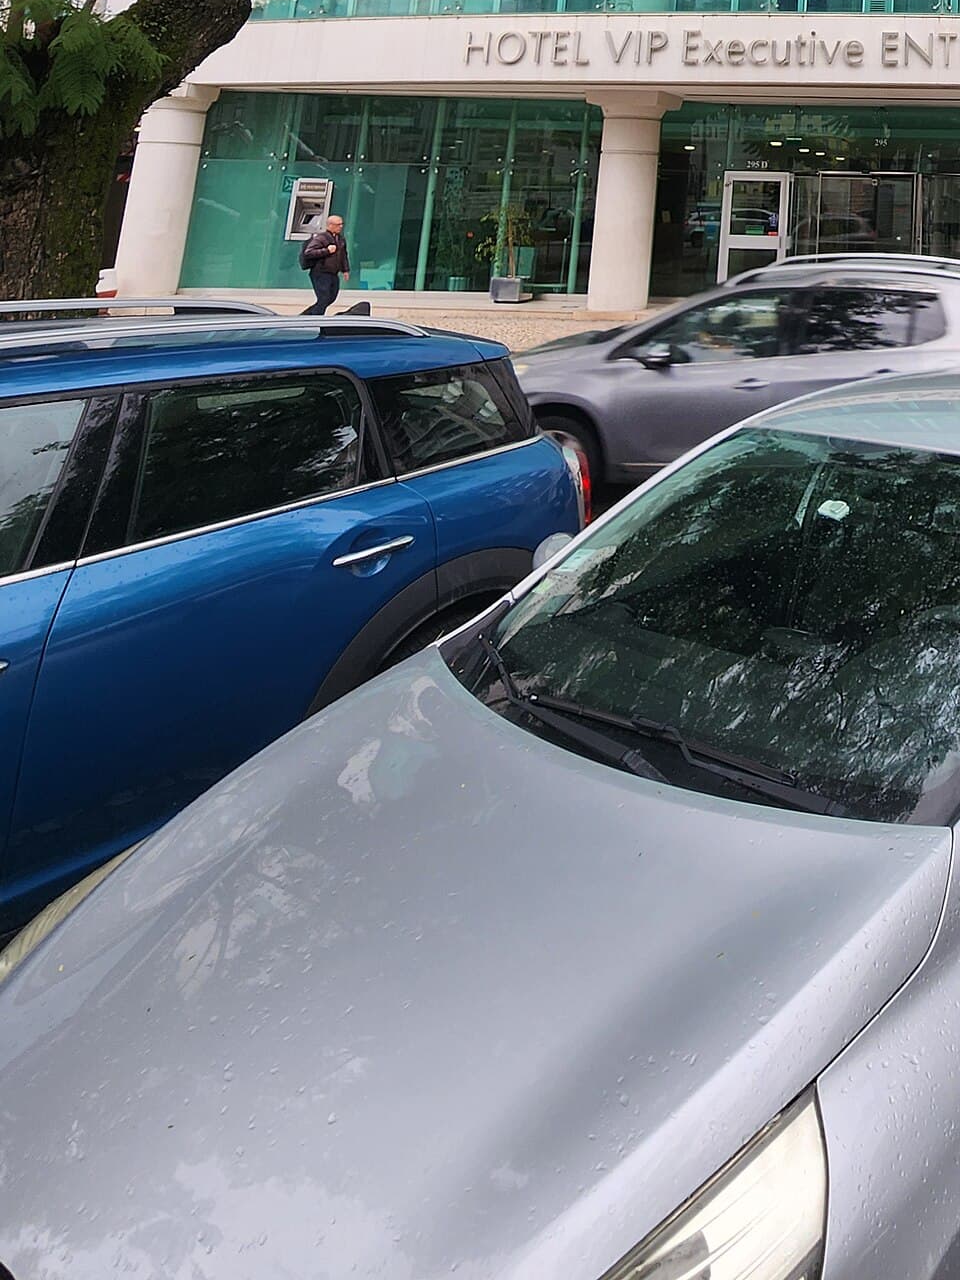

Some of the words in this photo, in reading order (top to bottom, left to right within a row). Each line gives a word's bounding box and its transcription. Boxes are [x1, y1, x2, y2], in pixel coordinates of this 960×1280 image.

[465, 30, 590, 66] HOTEL
[603, 30, 670, 65] VIP
[681, 29, 865, 66] Executive
[874, 138, 888, 147] 295
[746, 160, 760, 169] 295
